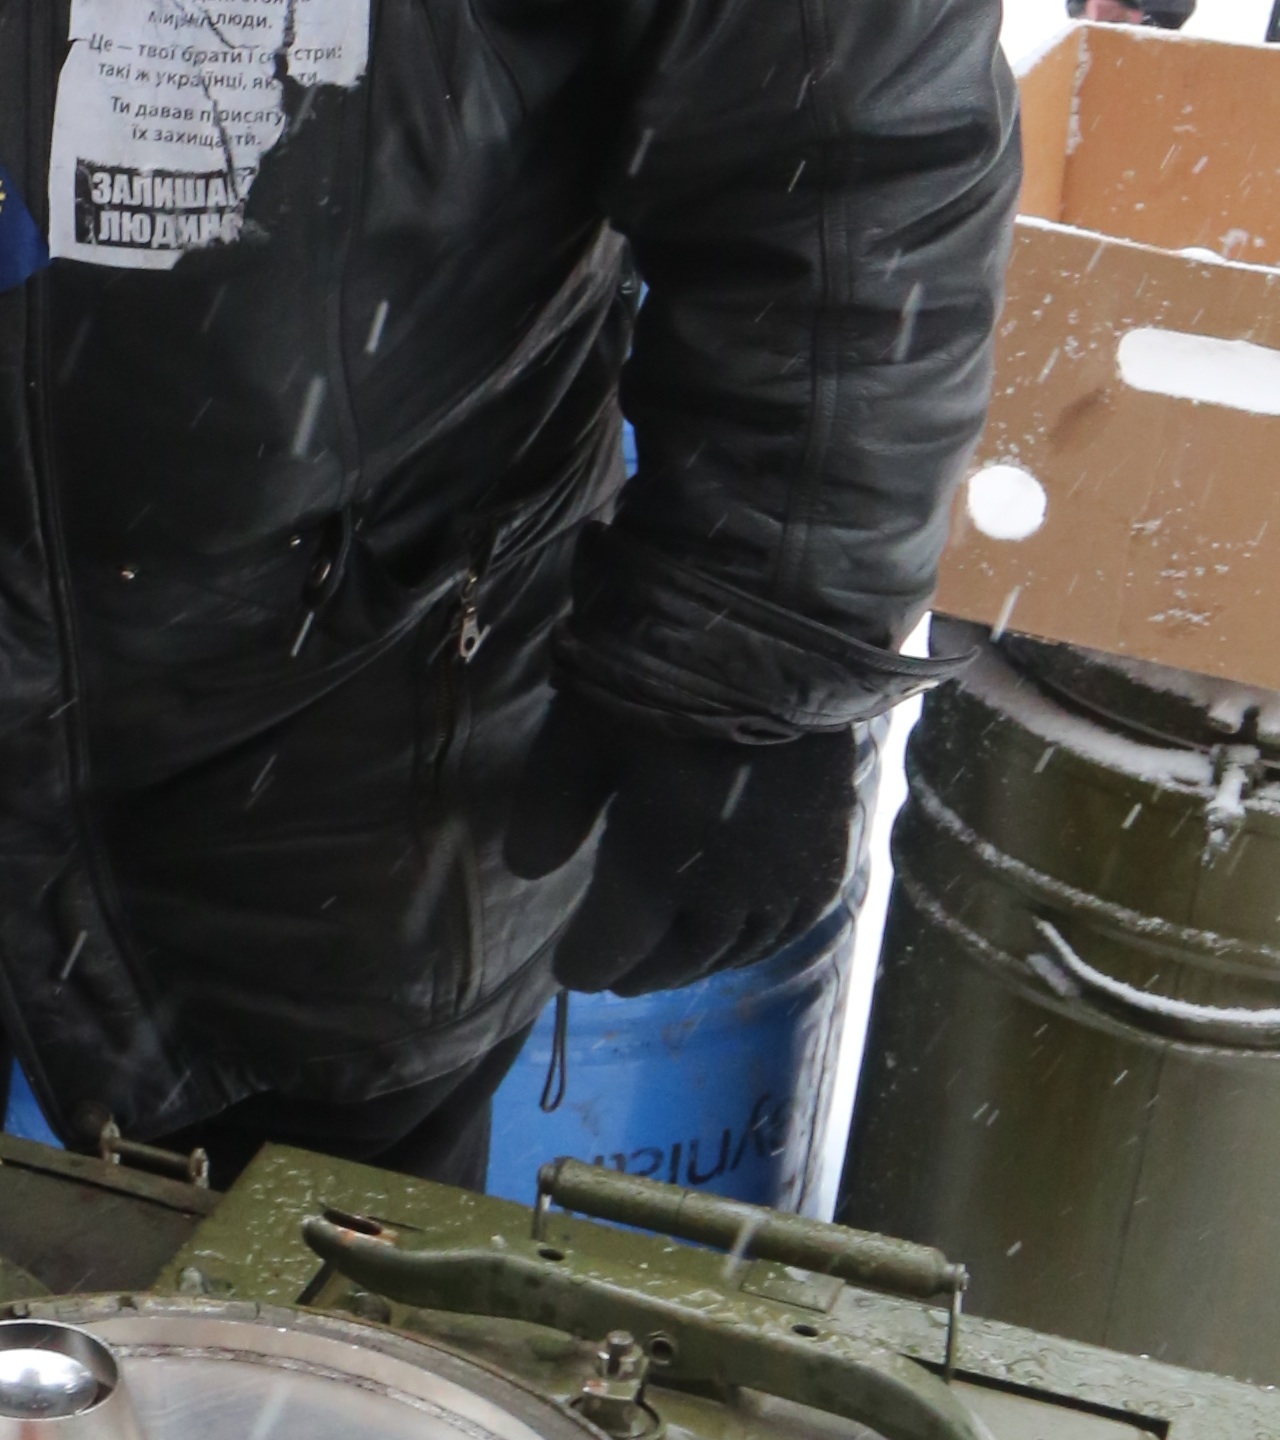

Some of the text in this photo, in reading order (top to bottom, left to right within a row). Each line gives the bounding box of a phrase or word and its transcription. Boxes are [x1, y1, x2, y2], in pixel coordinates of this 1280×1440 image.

[90, 33, 113, 52] Це
[98, 62, 131, 81] такі
[111, 95, 130, 114] Ти
[135, 101, 194, 122] давав
